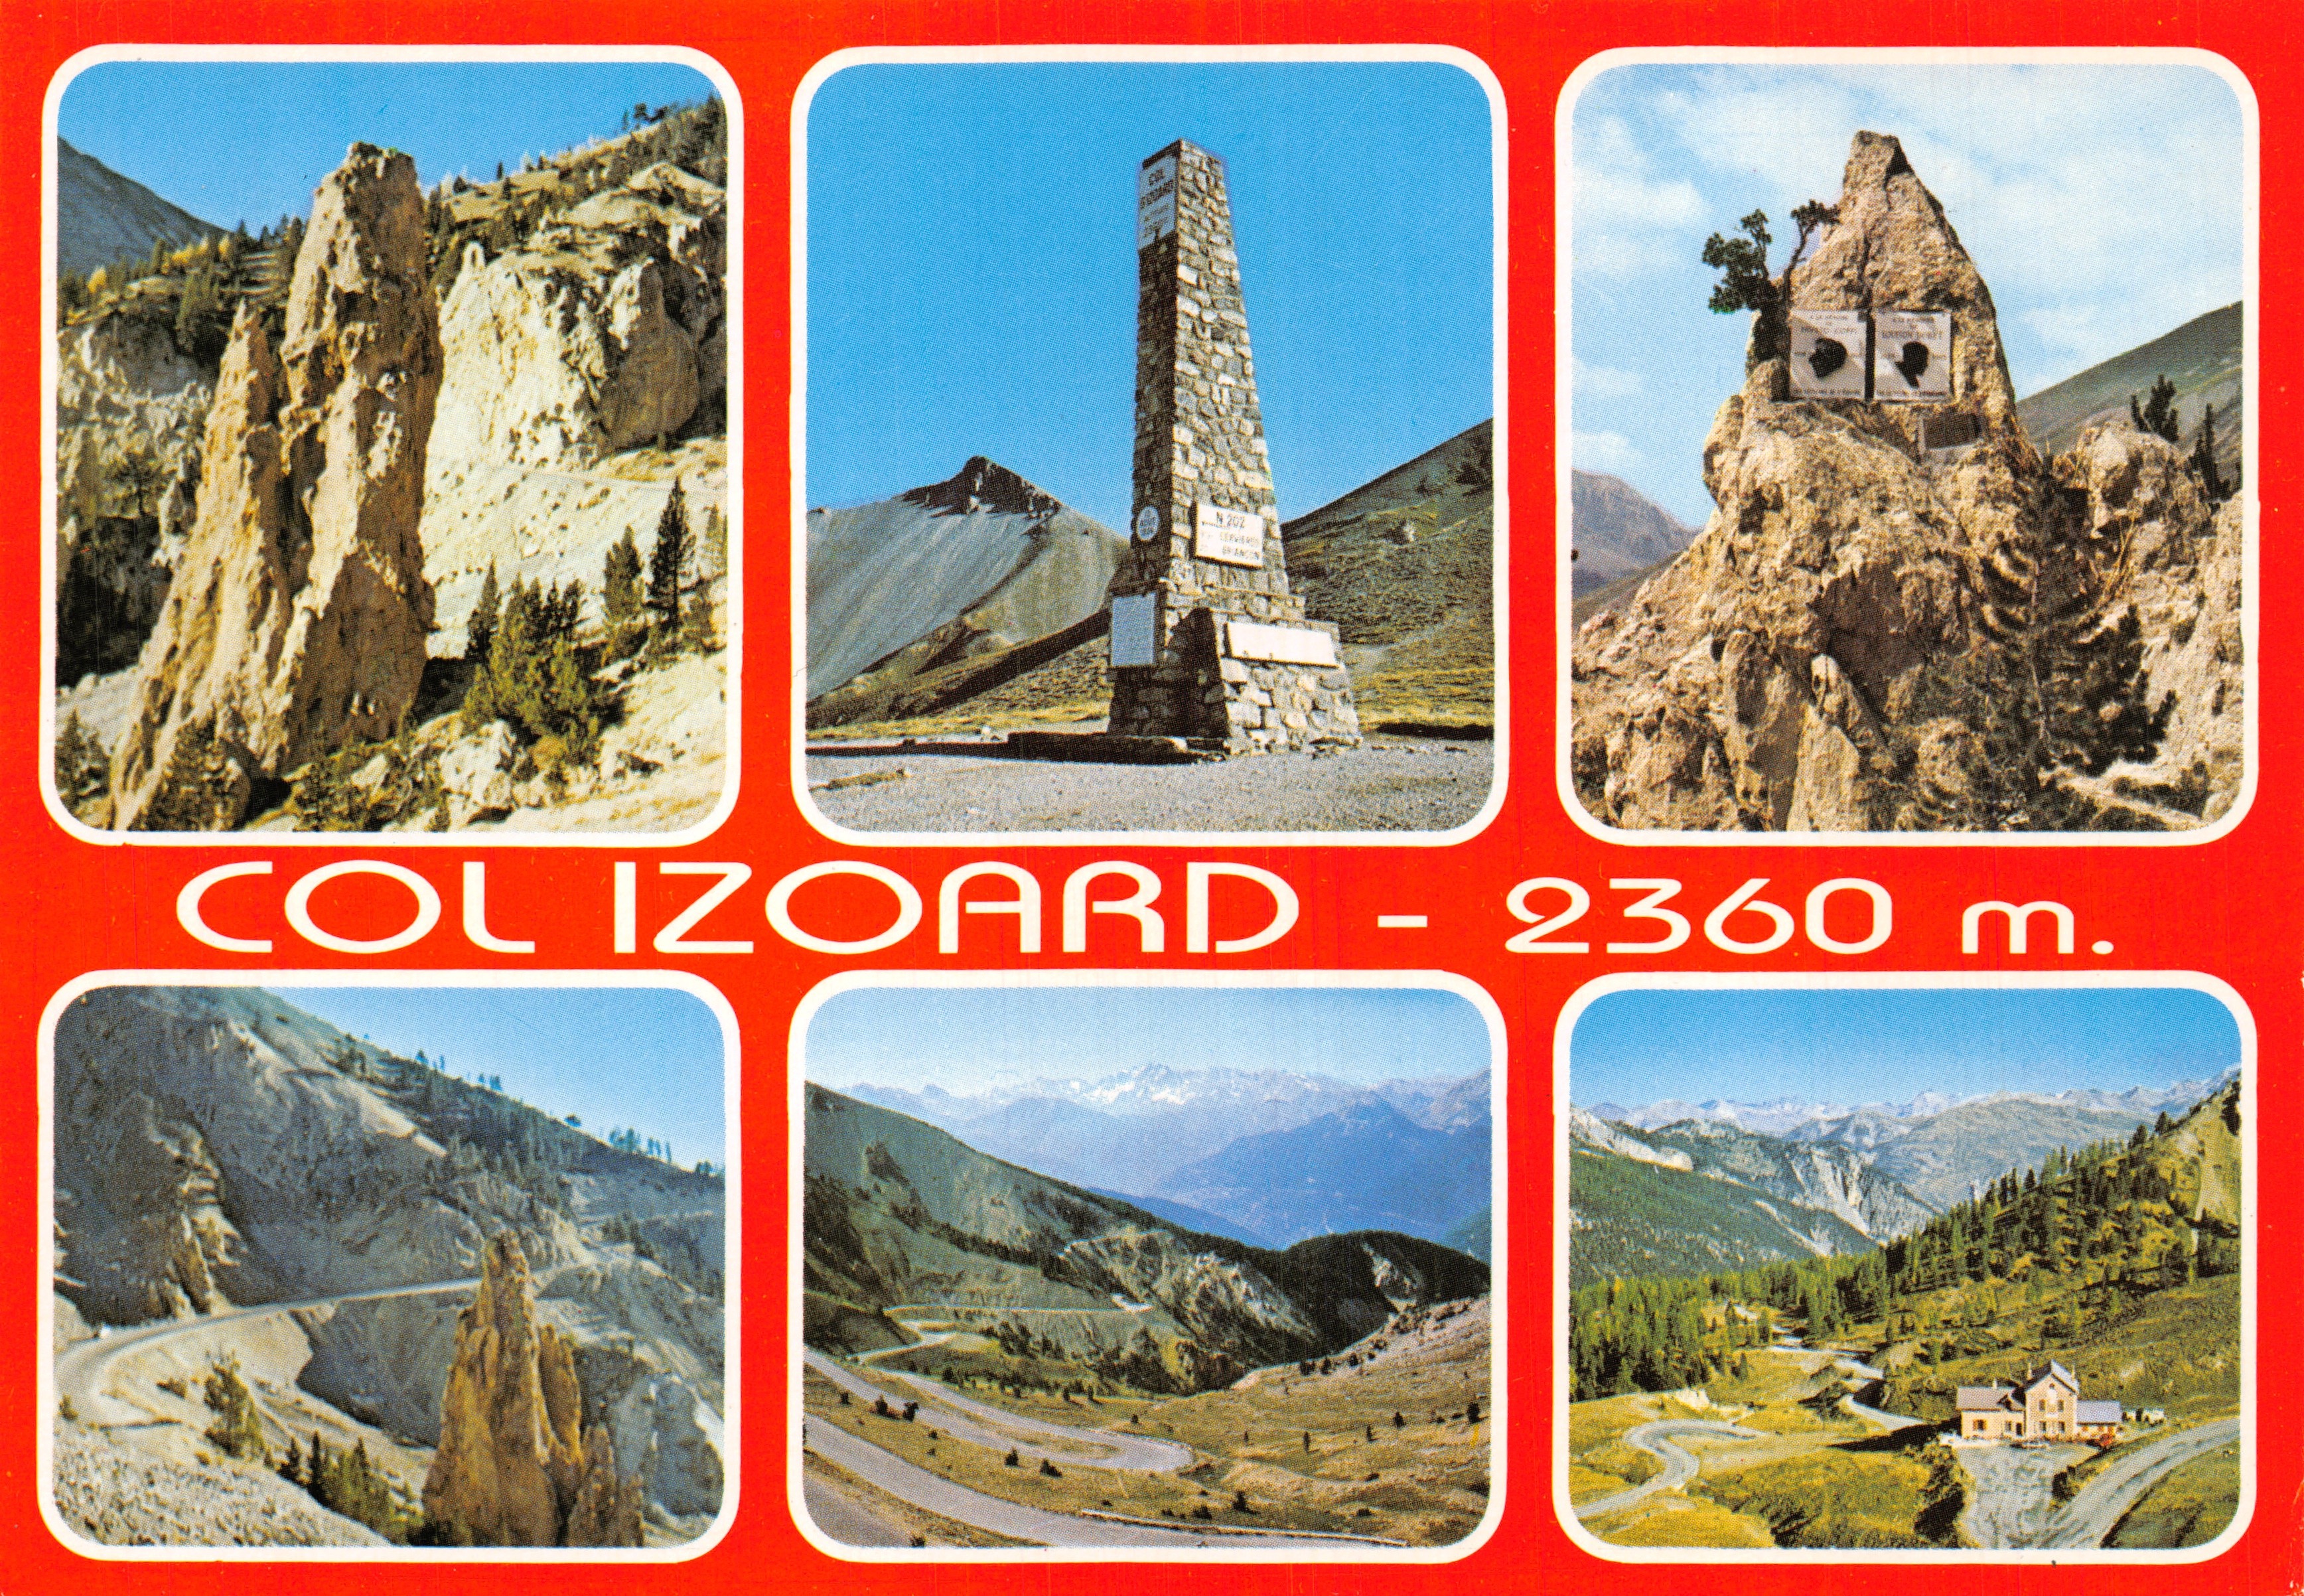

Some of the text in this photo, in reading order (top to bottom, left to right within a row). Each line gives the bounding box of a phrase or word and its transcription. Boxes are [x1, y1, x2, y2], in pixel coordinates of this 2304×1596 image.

[1216, 511, 1224, 525] N
[176, 860, 536, 956] COL
[614, 860, 1299, 956] IZOARD
[1504, 877, 1893, 956] 2360
[1962, 901, 2115, 956] m.
